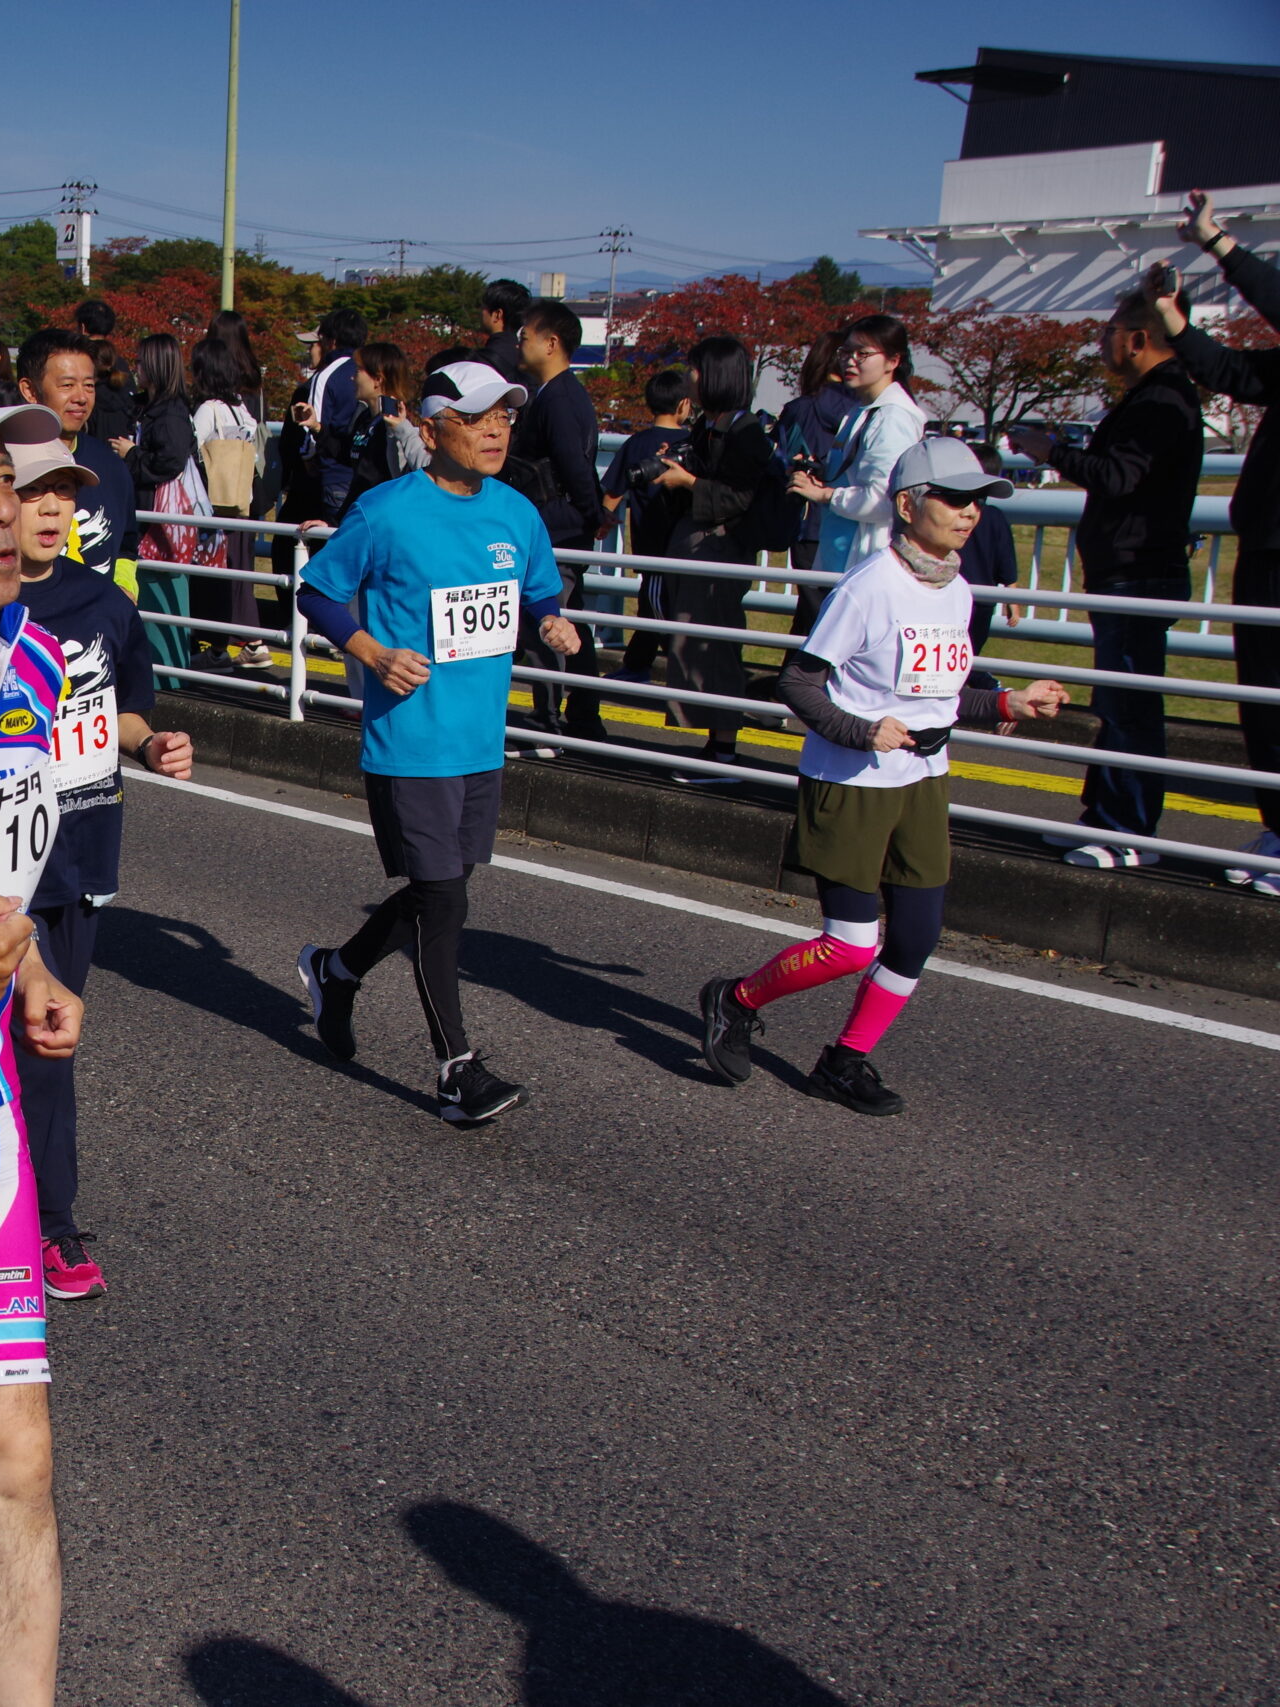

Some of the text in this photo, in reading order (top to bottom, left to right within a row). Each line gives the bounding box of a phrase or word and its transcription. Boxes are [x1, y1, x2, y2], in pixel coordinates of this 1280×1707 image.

[446, 585, 508, 604] 福島トヨタ
[445, 601, 511, 637] 1905
[911, 643, 969, 672] 2136
[4, 714, 29, 729] MAVIC
[5, 1369, 29, 1377] Santini
